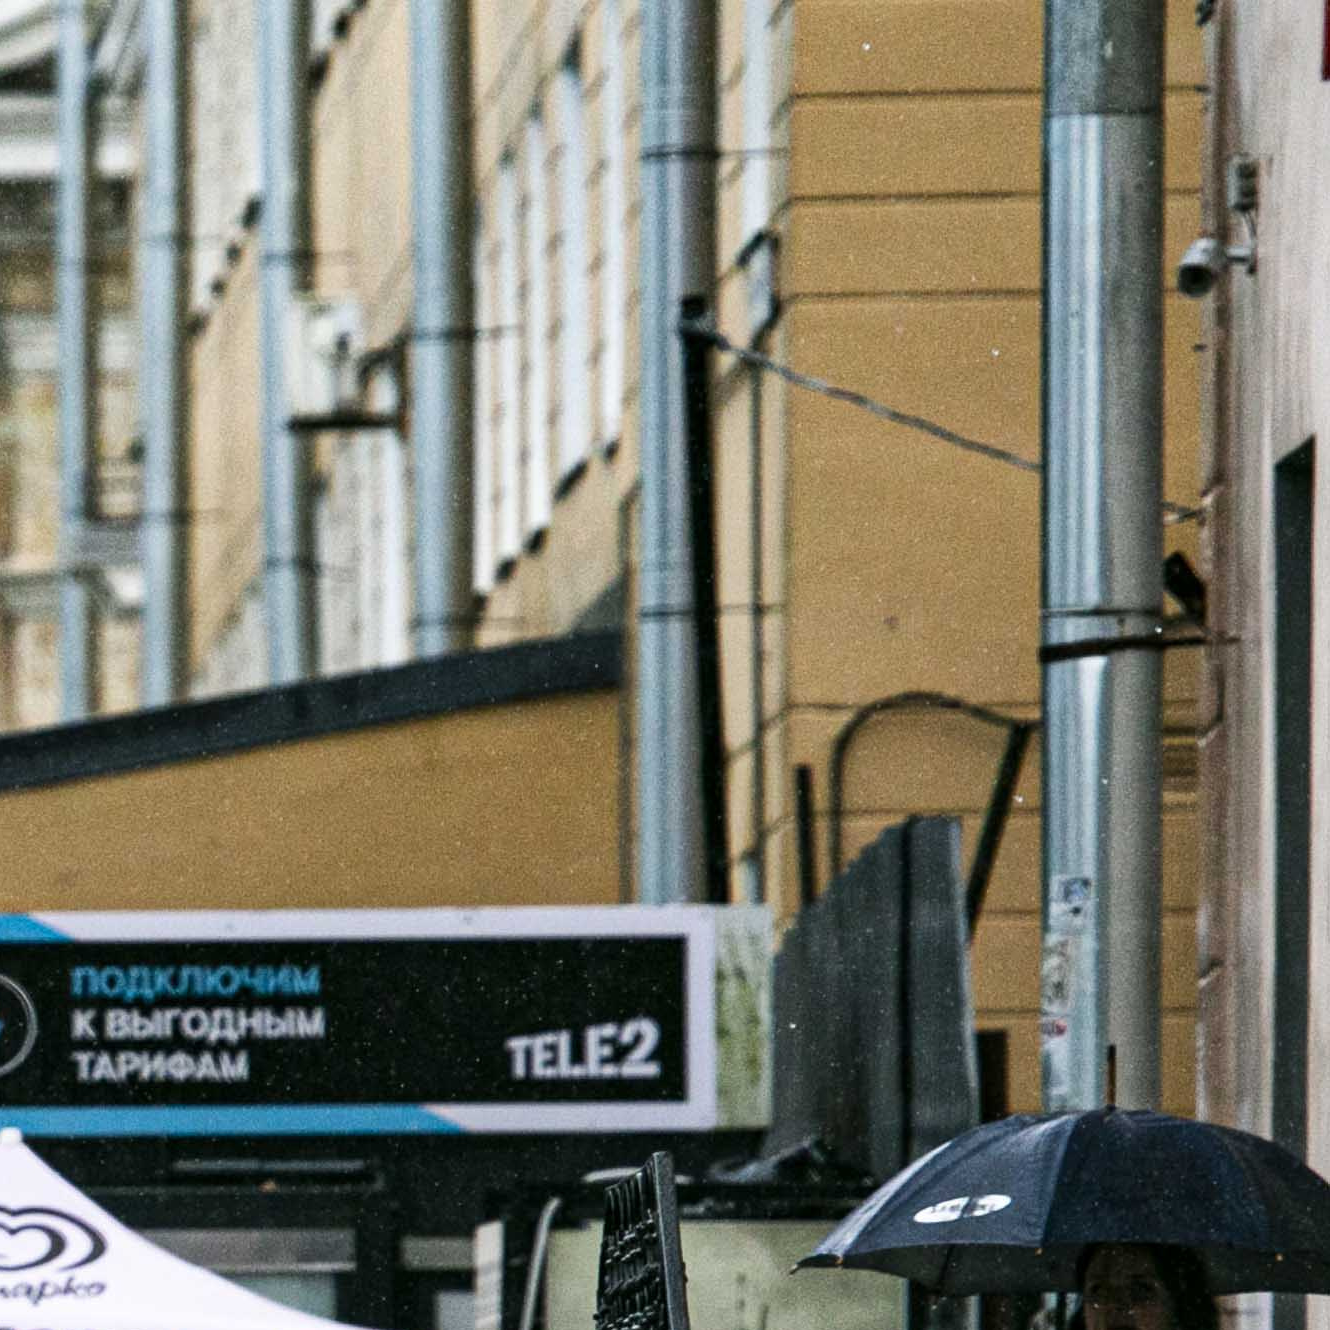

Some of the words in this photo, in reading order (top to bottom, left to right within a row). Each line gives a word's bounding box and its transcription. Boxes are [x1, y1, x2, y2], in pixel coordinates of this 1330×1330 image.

[71, 965, 321, 1002] ПОДКЛЮЧИМ
[71, 1008, 96, 1040] К
[105, 1006, 326, 1046] ВЫГОДНЫМ
[73, 1050, 250, 1083] ТАРИФАМ
[505, 1016, 661, 1079] TELE2
